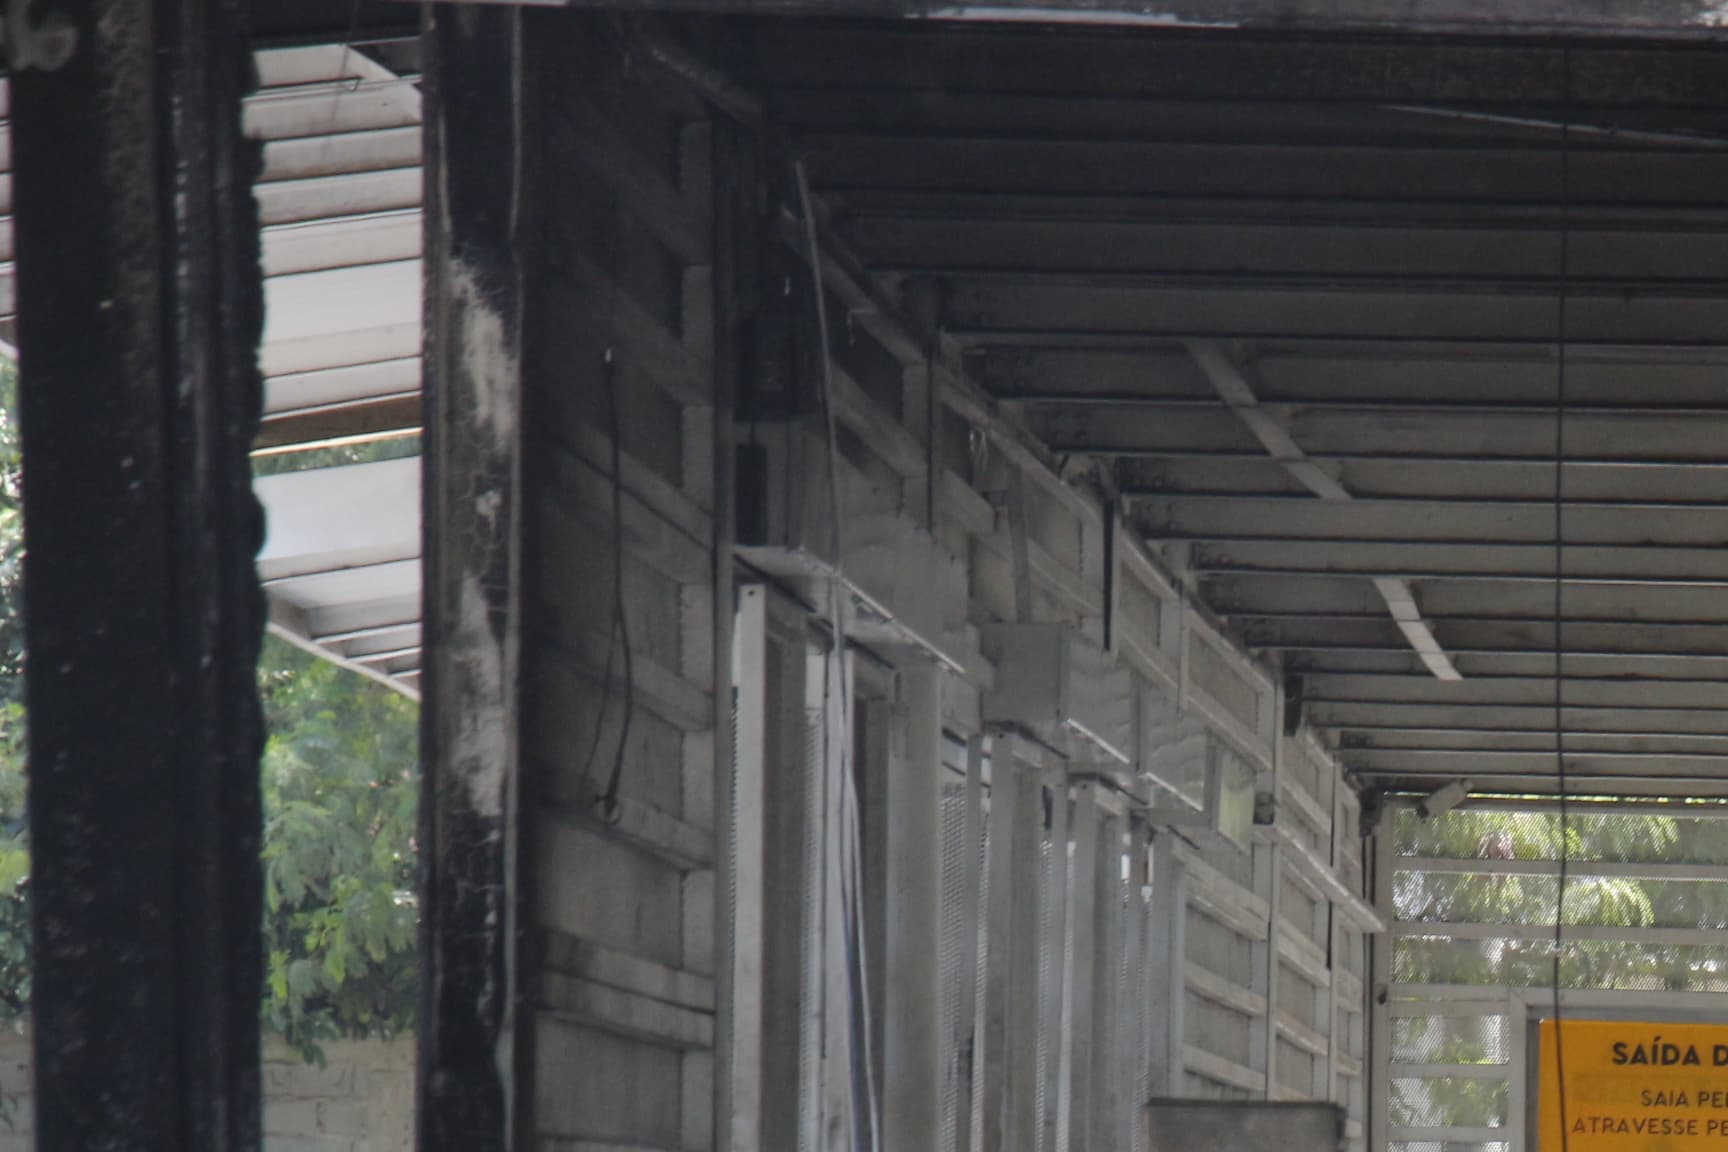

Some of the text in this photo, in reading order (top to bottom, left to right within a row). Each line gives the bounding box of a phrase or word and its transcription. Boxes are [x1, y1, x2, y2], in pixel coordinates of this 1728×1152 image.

[1611, 1036, 1701, 1066] SAÍDA
[1641, 1089, 1689, 1107] SAIA
[1572, 1117, 1699, 1136] ATRAVESSE
